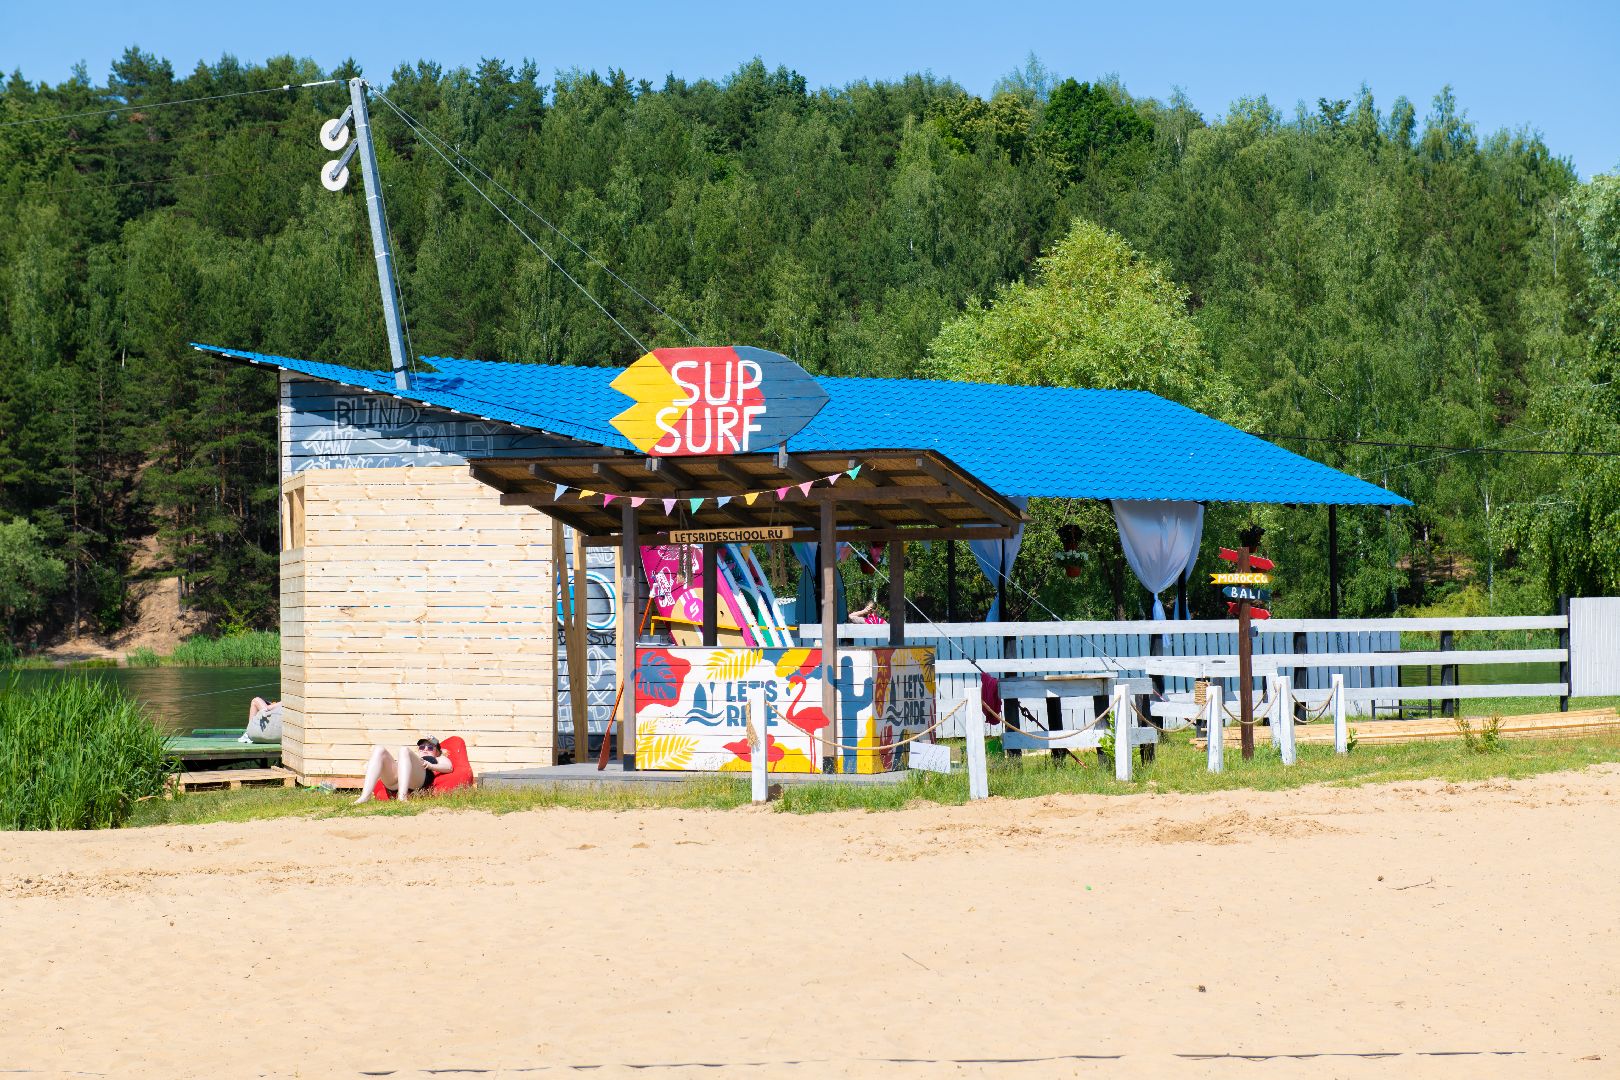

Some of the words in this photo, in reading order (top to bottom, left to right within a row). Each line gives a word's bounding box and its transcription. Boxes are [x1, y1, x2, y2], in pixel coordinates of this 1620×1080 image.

[671, 360, 763, 406] SUP
[654, 405, 767, 453] SURF
[674, 529, 783, 543] LETSRIDESCHOOL.RU
[1217, 573, 1269, 584] MOROCCO
[1231, 586, 1261, 600] BALI
[903, 673, 925, 699] LET'S
[726, 704, 778, 727] RIE
[903, 701, 926, 726] RIDE
